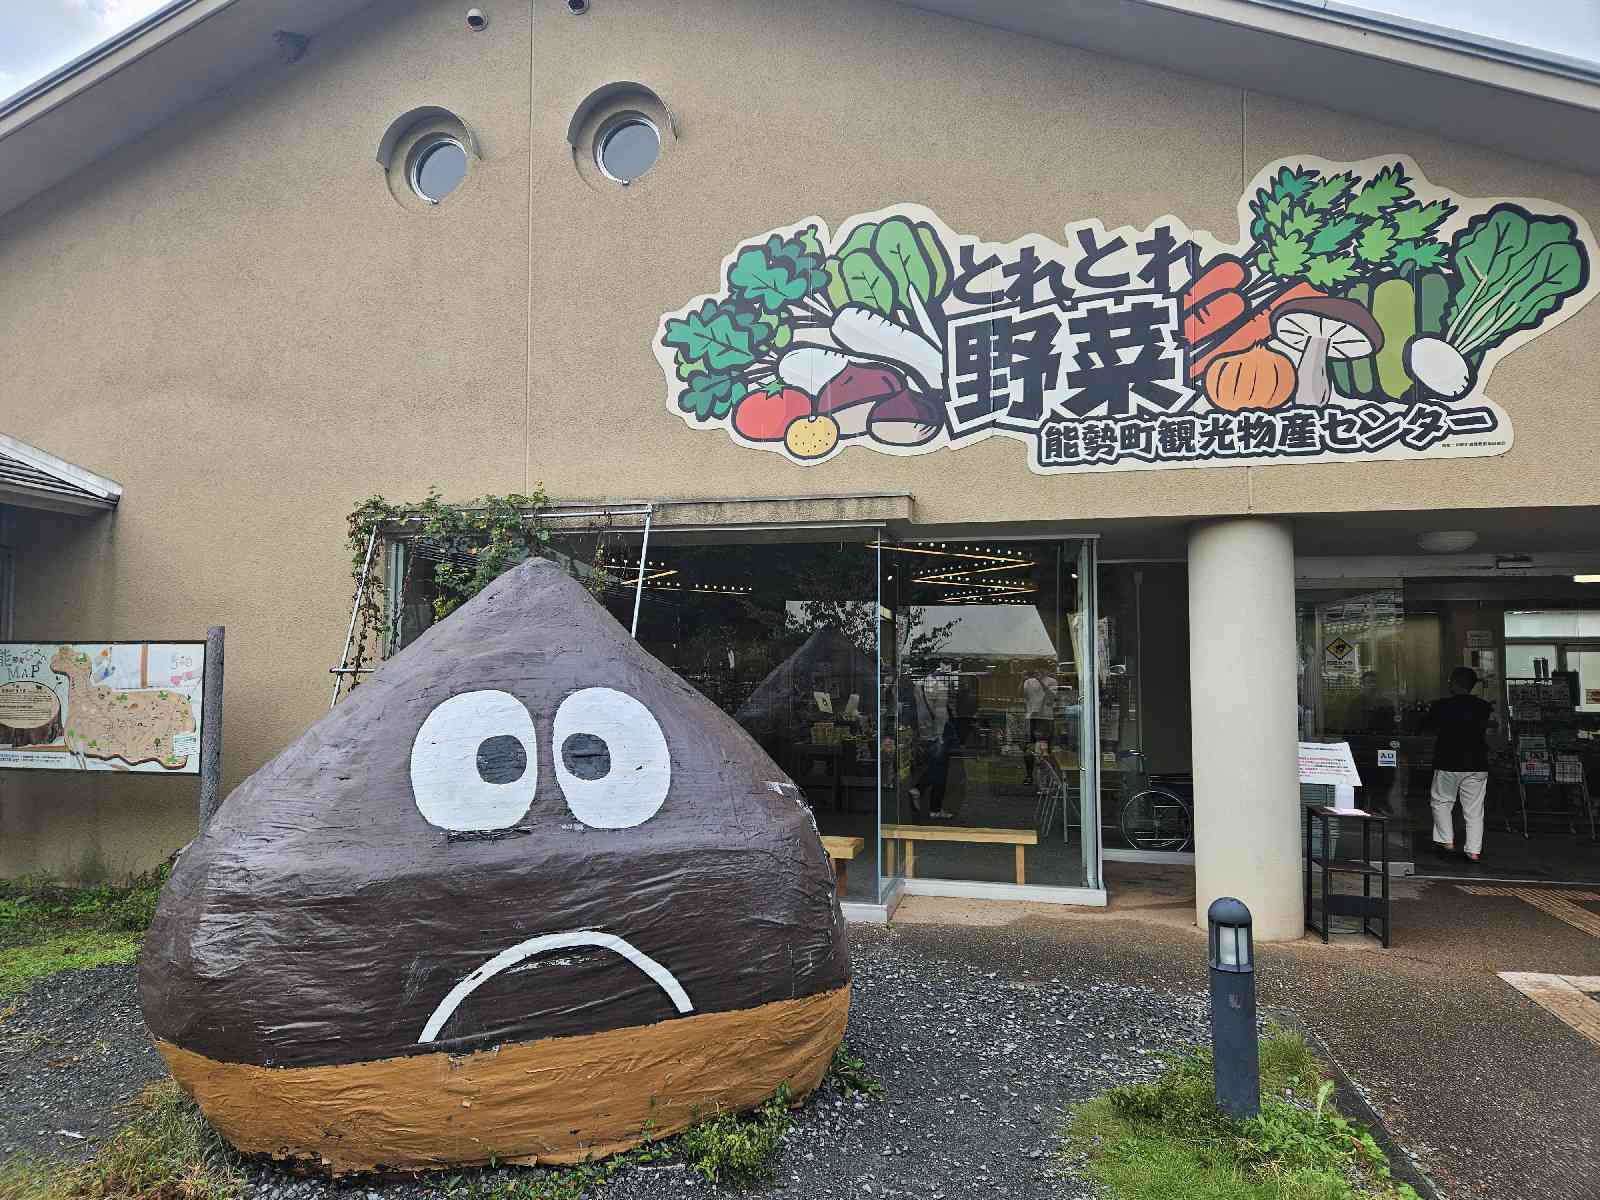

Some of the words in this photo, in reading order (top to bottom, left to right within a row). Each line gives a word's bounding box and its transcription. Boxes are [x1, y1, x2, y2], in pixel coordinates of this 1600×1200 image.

[953, 225, 1203, 304] とれとれ
[952, 301, 1184, 424] 野菜
[1043, 404, 1494, 460] 能勢町観光物産センター
